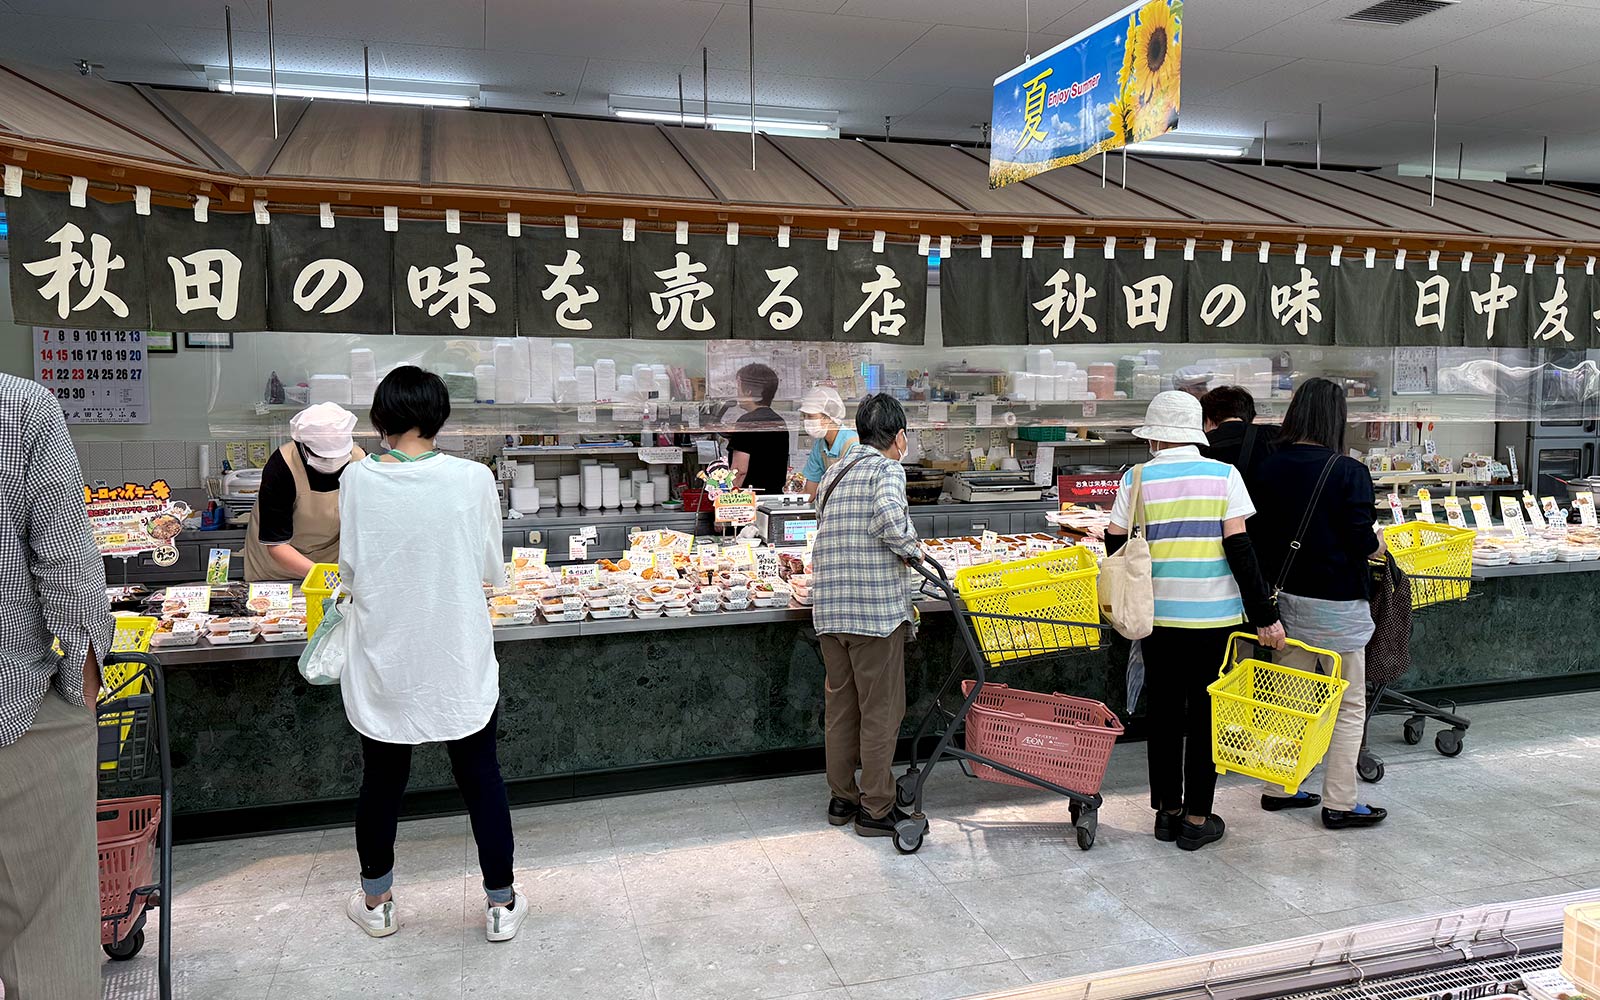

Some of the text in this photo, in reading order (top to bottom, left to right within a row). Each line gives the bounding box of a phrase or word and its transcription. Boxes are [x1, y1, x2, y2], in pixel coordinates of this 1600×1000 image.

[1047, 73, 1101, 107] Enjoy Summer
[1015, 68, 1054, 154] 夏
[22, 222, 908, 338] 秋田の味を売る店
[1031, 267, 1600, 343] 秋田の味 日中友
[43, 330, 141, 342] 7 8 9 10 11 12 13
[41, 350, 141, 361] 14 15 16 17 18 19 20
[42, 369, 142, 380] 21 22 23 24 25 26 27
[57, 388, 70, 399] 29
[72, 388, 85, 399] 30
